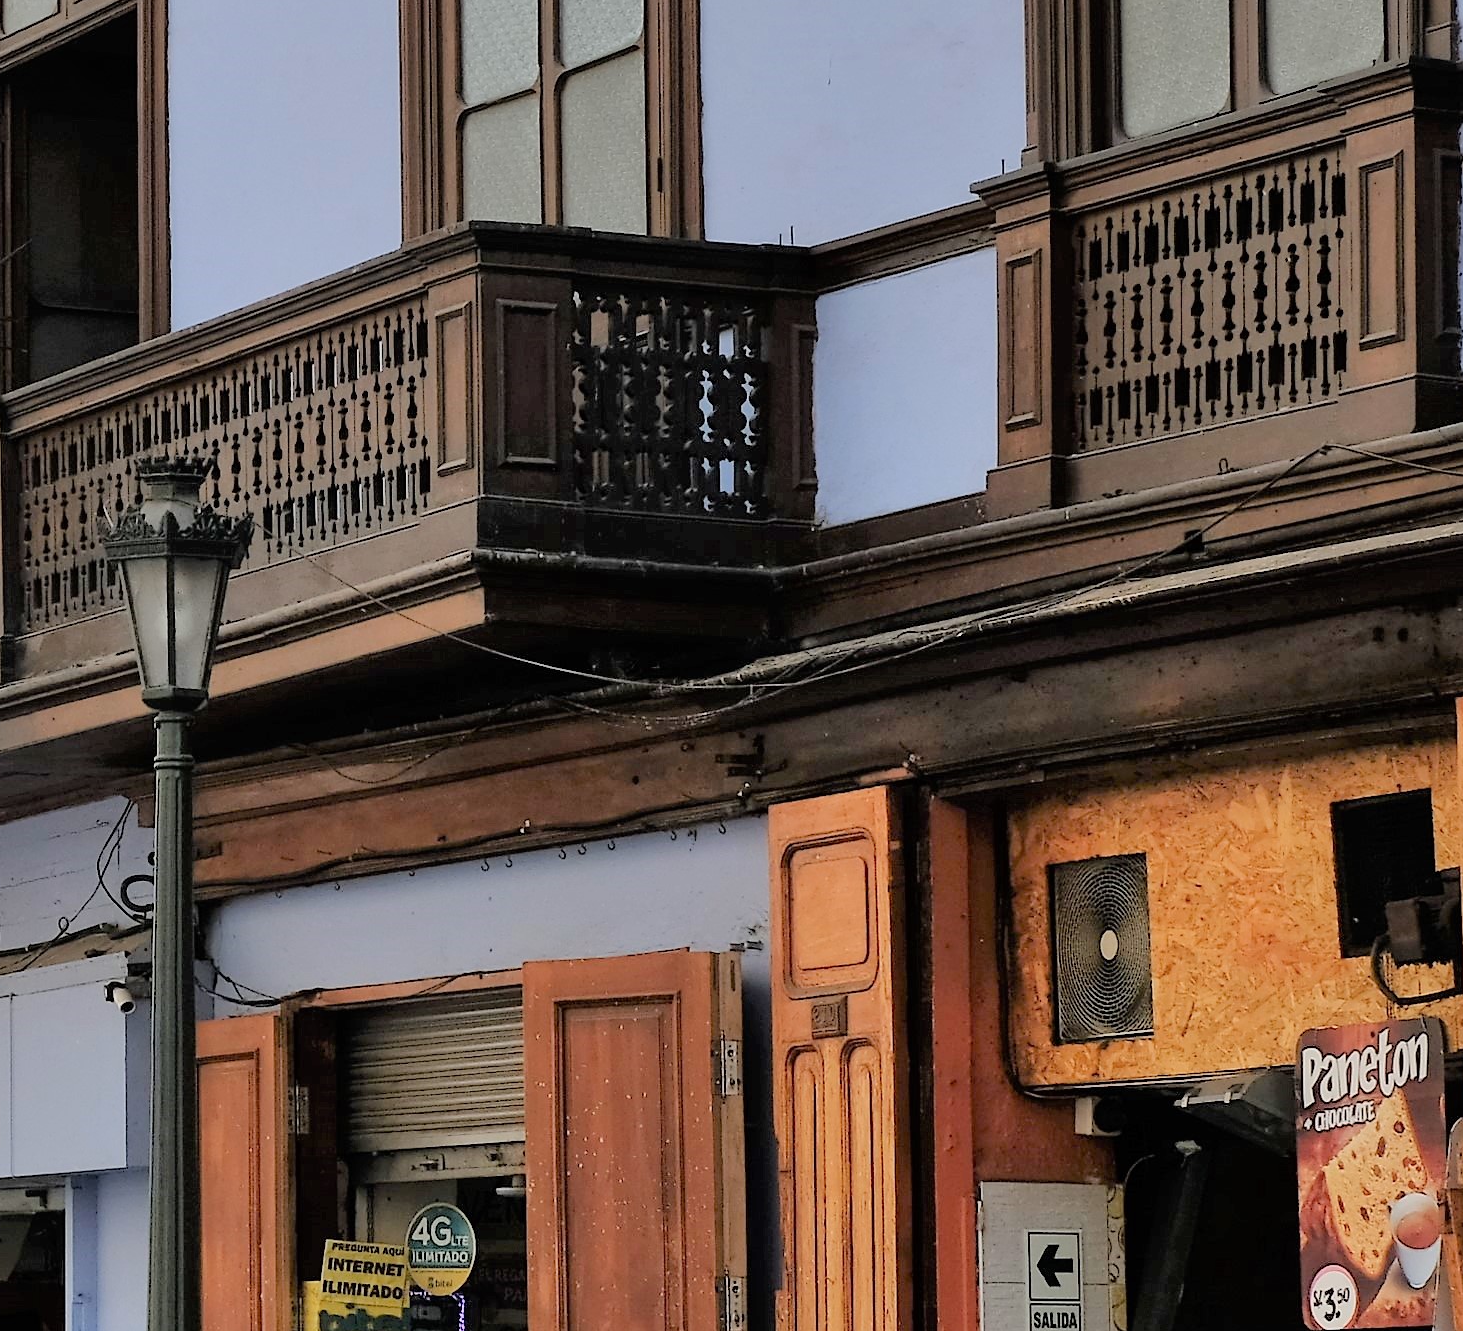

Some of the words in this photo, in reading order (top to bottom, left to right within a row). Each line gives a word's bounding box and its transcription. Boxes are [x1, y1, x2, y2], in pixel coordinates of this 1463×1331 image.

[1301, 1027, 1429, 1109] Paneton
[1314, 1099, 1376, 1132] CHOCOLATE
[331, 1242, 380, 1255] PREGUNTA
[411, 1250, 470, 1263] ILIMITADO
[327, 1257, 405, 1277] INTERNET
[322, 1279, 404, 1300] ILIMITADO
[1033, 1311, 1078, 1329] SALIDA
